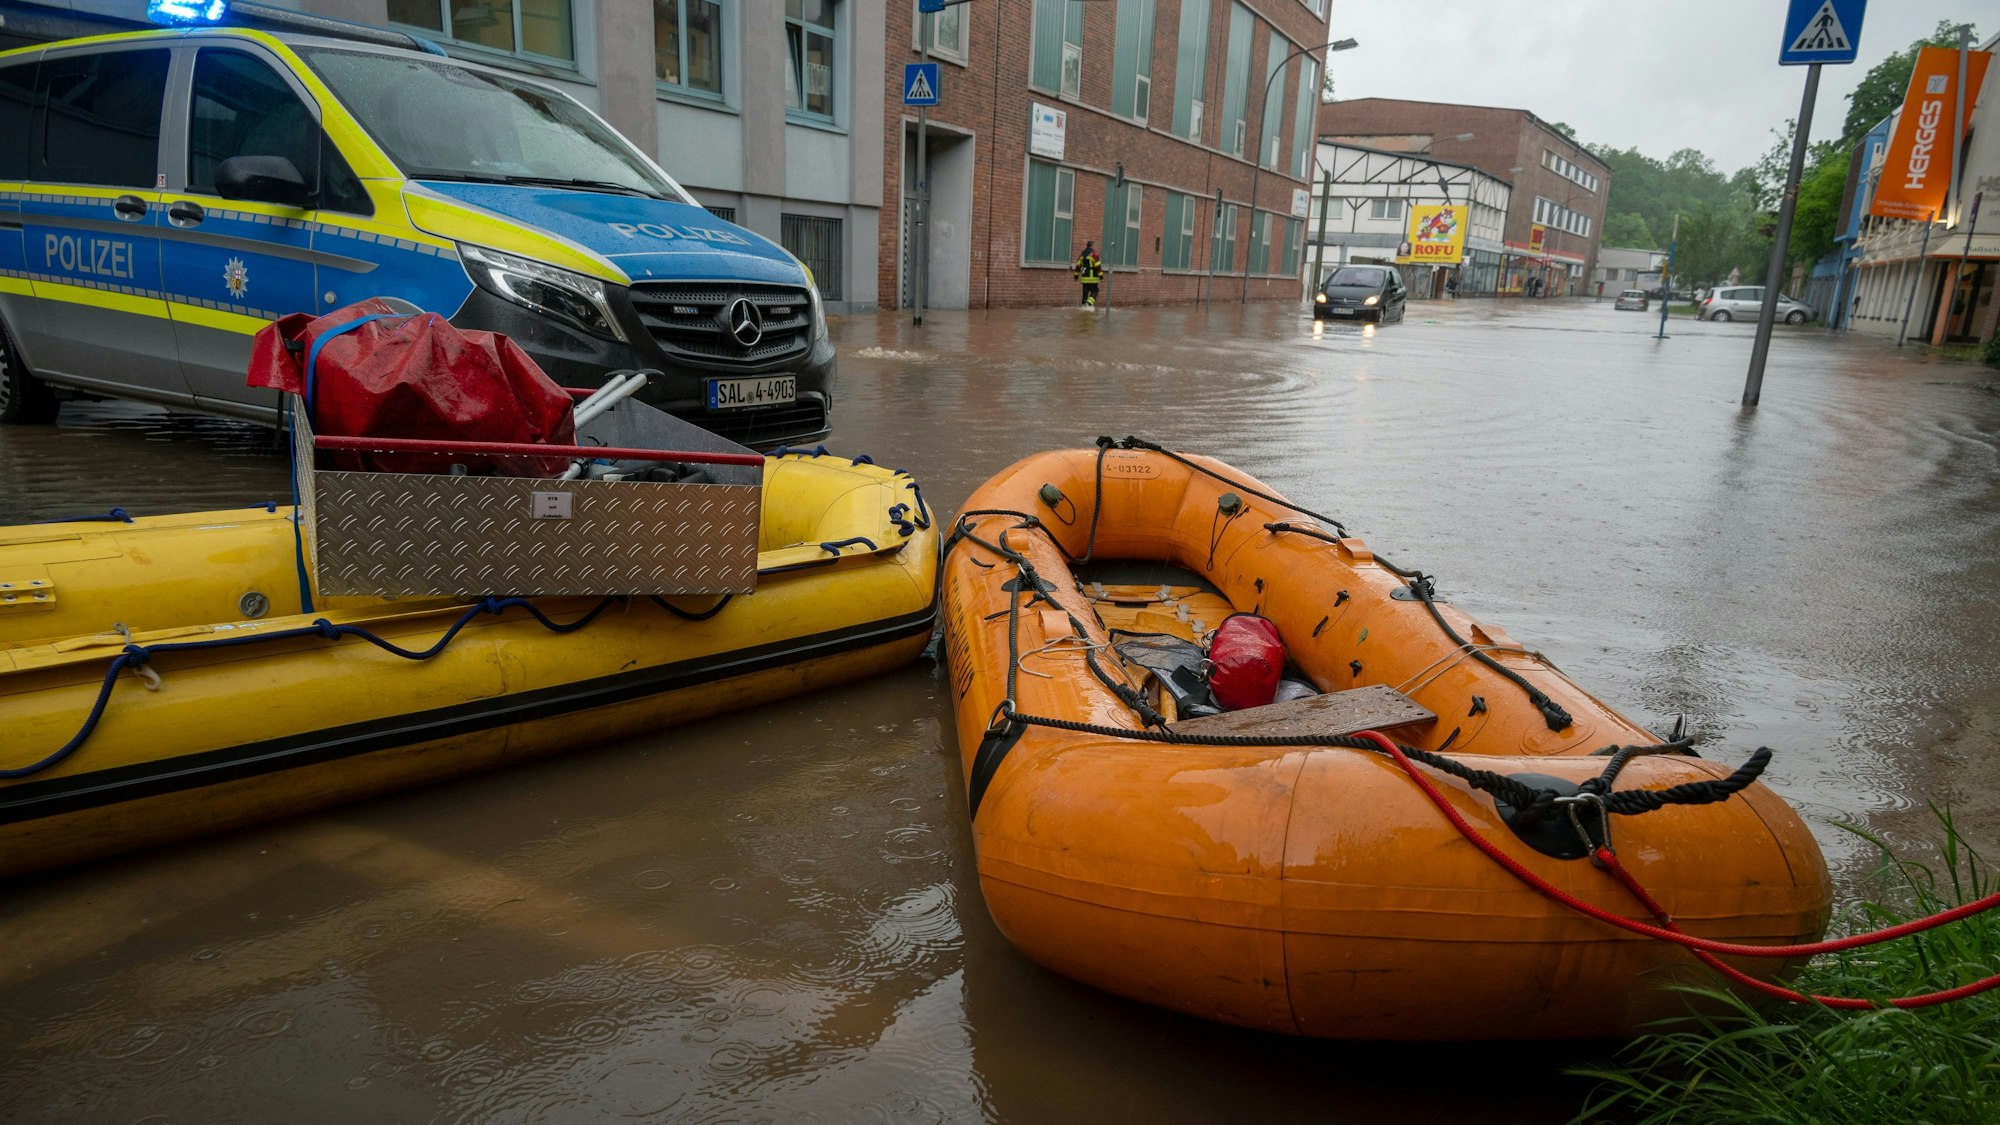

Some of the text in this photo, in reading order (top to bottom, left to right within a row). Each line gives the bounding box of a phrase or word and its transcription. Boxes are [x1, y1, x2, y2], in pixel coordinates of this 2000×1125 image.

[1904, 100, 1942, 189] HERGES
[607, 222, 753, 246] POLIZEI
[45, 234, 134, 279] POLIZEI
[1414, 244, 1455, 255] ROFU
[719, 383, 745, 404] SAL
[756, 379, 795, 402] 4-4903
[1105, 464, 1152, 474] 4-03122
